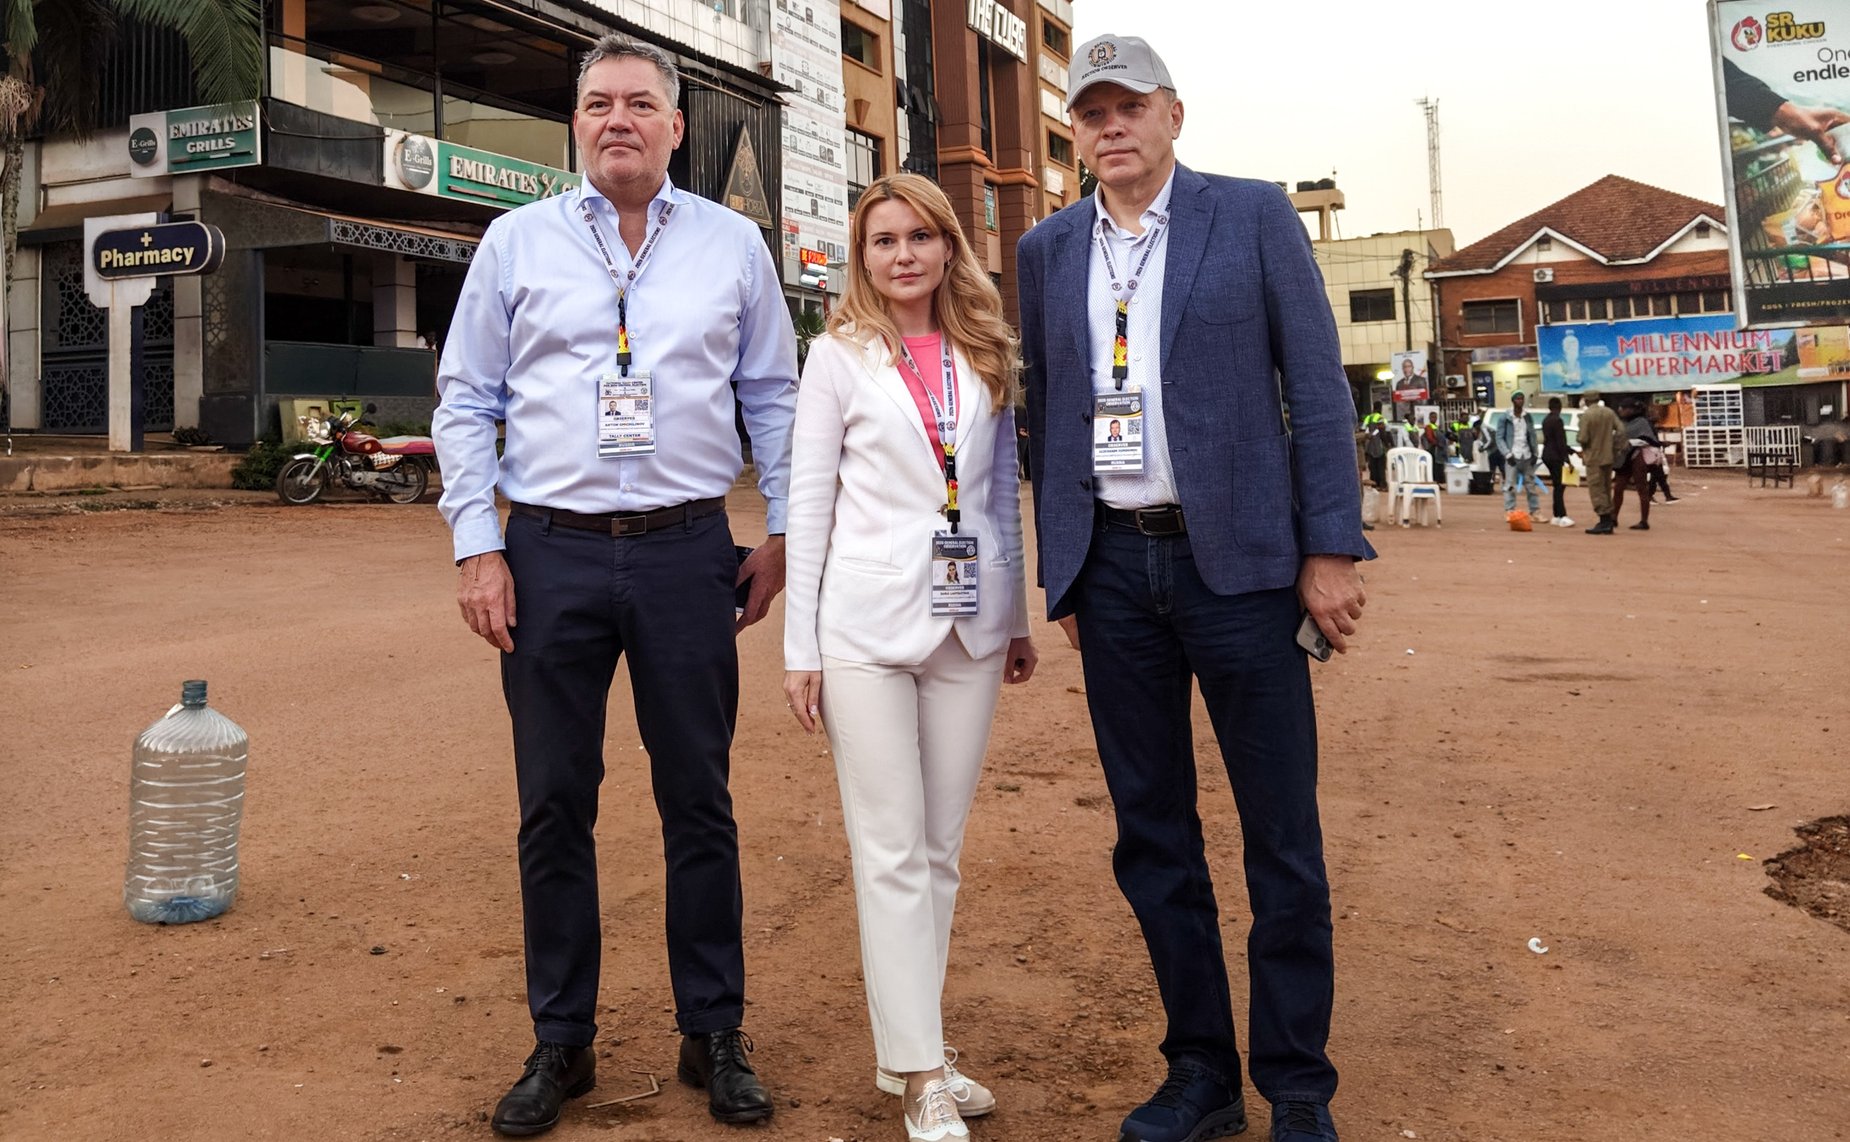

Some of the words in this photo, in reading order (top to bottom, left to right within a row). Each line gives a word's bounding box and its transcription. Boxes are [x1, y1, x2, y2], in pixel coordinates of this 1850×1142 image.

[993, 0, 1027, 63] CUBE
[1766, 11, 1794, 27] SR
[1766, 22, 1825, 43] KUKU
[169, 114, 254, 139] EMIRATES
[186, 137, 236, 154] GRILLS
[404, 148, 433, 167] E-Grills
[449, 153, 539, 195] EMIRATES
[640, 243, 651, 260] GENERAL
[648, 226, 661, 244] ELECTIONS
[1139, 250, 1151, 267] GENERAL
[1147, 228, 1160, 250] ELECTIONS
[100, 246, 195, 269] Pharmacy
[1618, 329, 1772, 355] MILLENNIUM
[1611, 350, 1784, 378] SUPERMARKET
